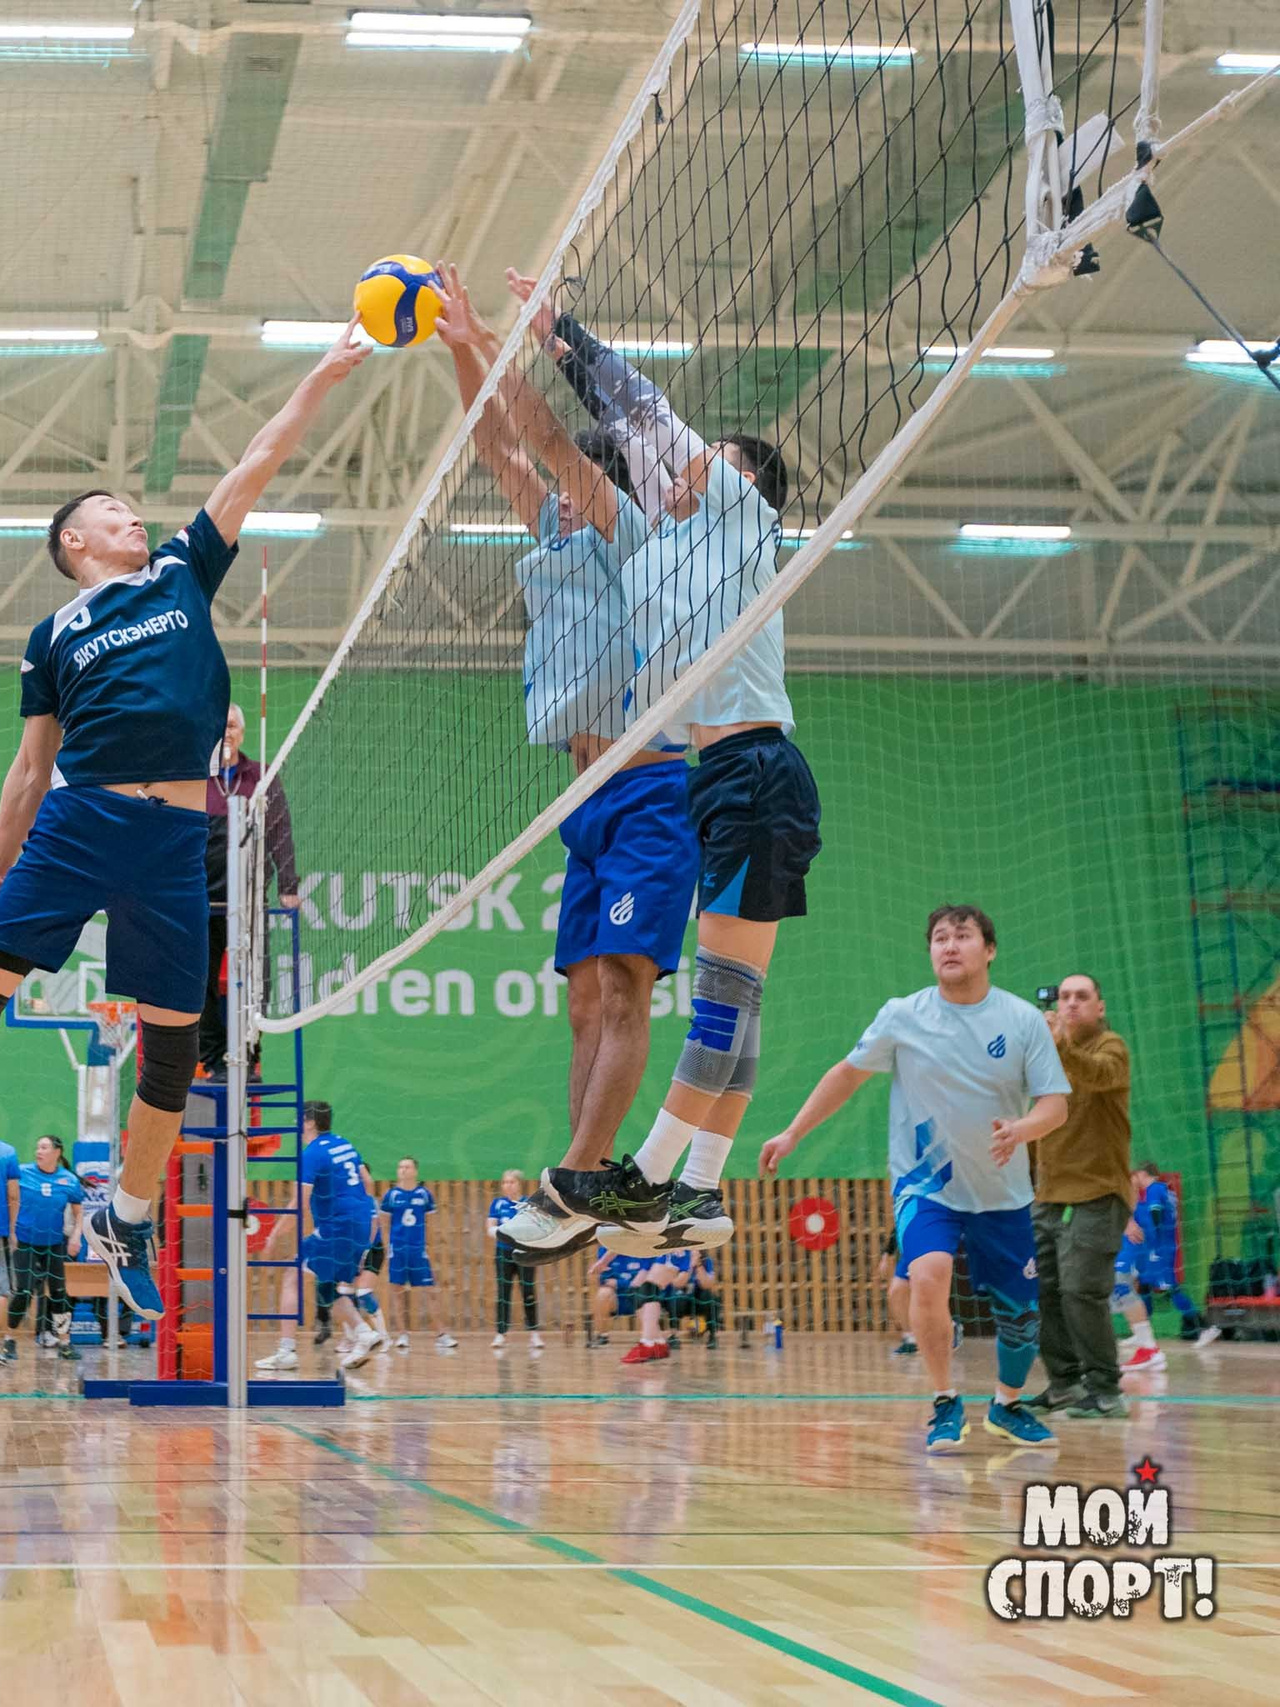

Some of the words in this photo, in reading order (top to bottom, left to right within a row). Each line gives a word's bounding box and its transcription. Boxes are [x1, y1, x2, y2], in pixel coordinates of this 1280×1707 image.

[73, 609, 189, 672] ЯКУТСКЭНЕРГО
[268, 871, 525, 931] KUTSK
[267, 953, 475, 1017] ildren
[493, 955, 568, 1017] of
[343, 1161, 360, 1186] 3
[401, 1208, 417, 1227] 6
